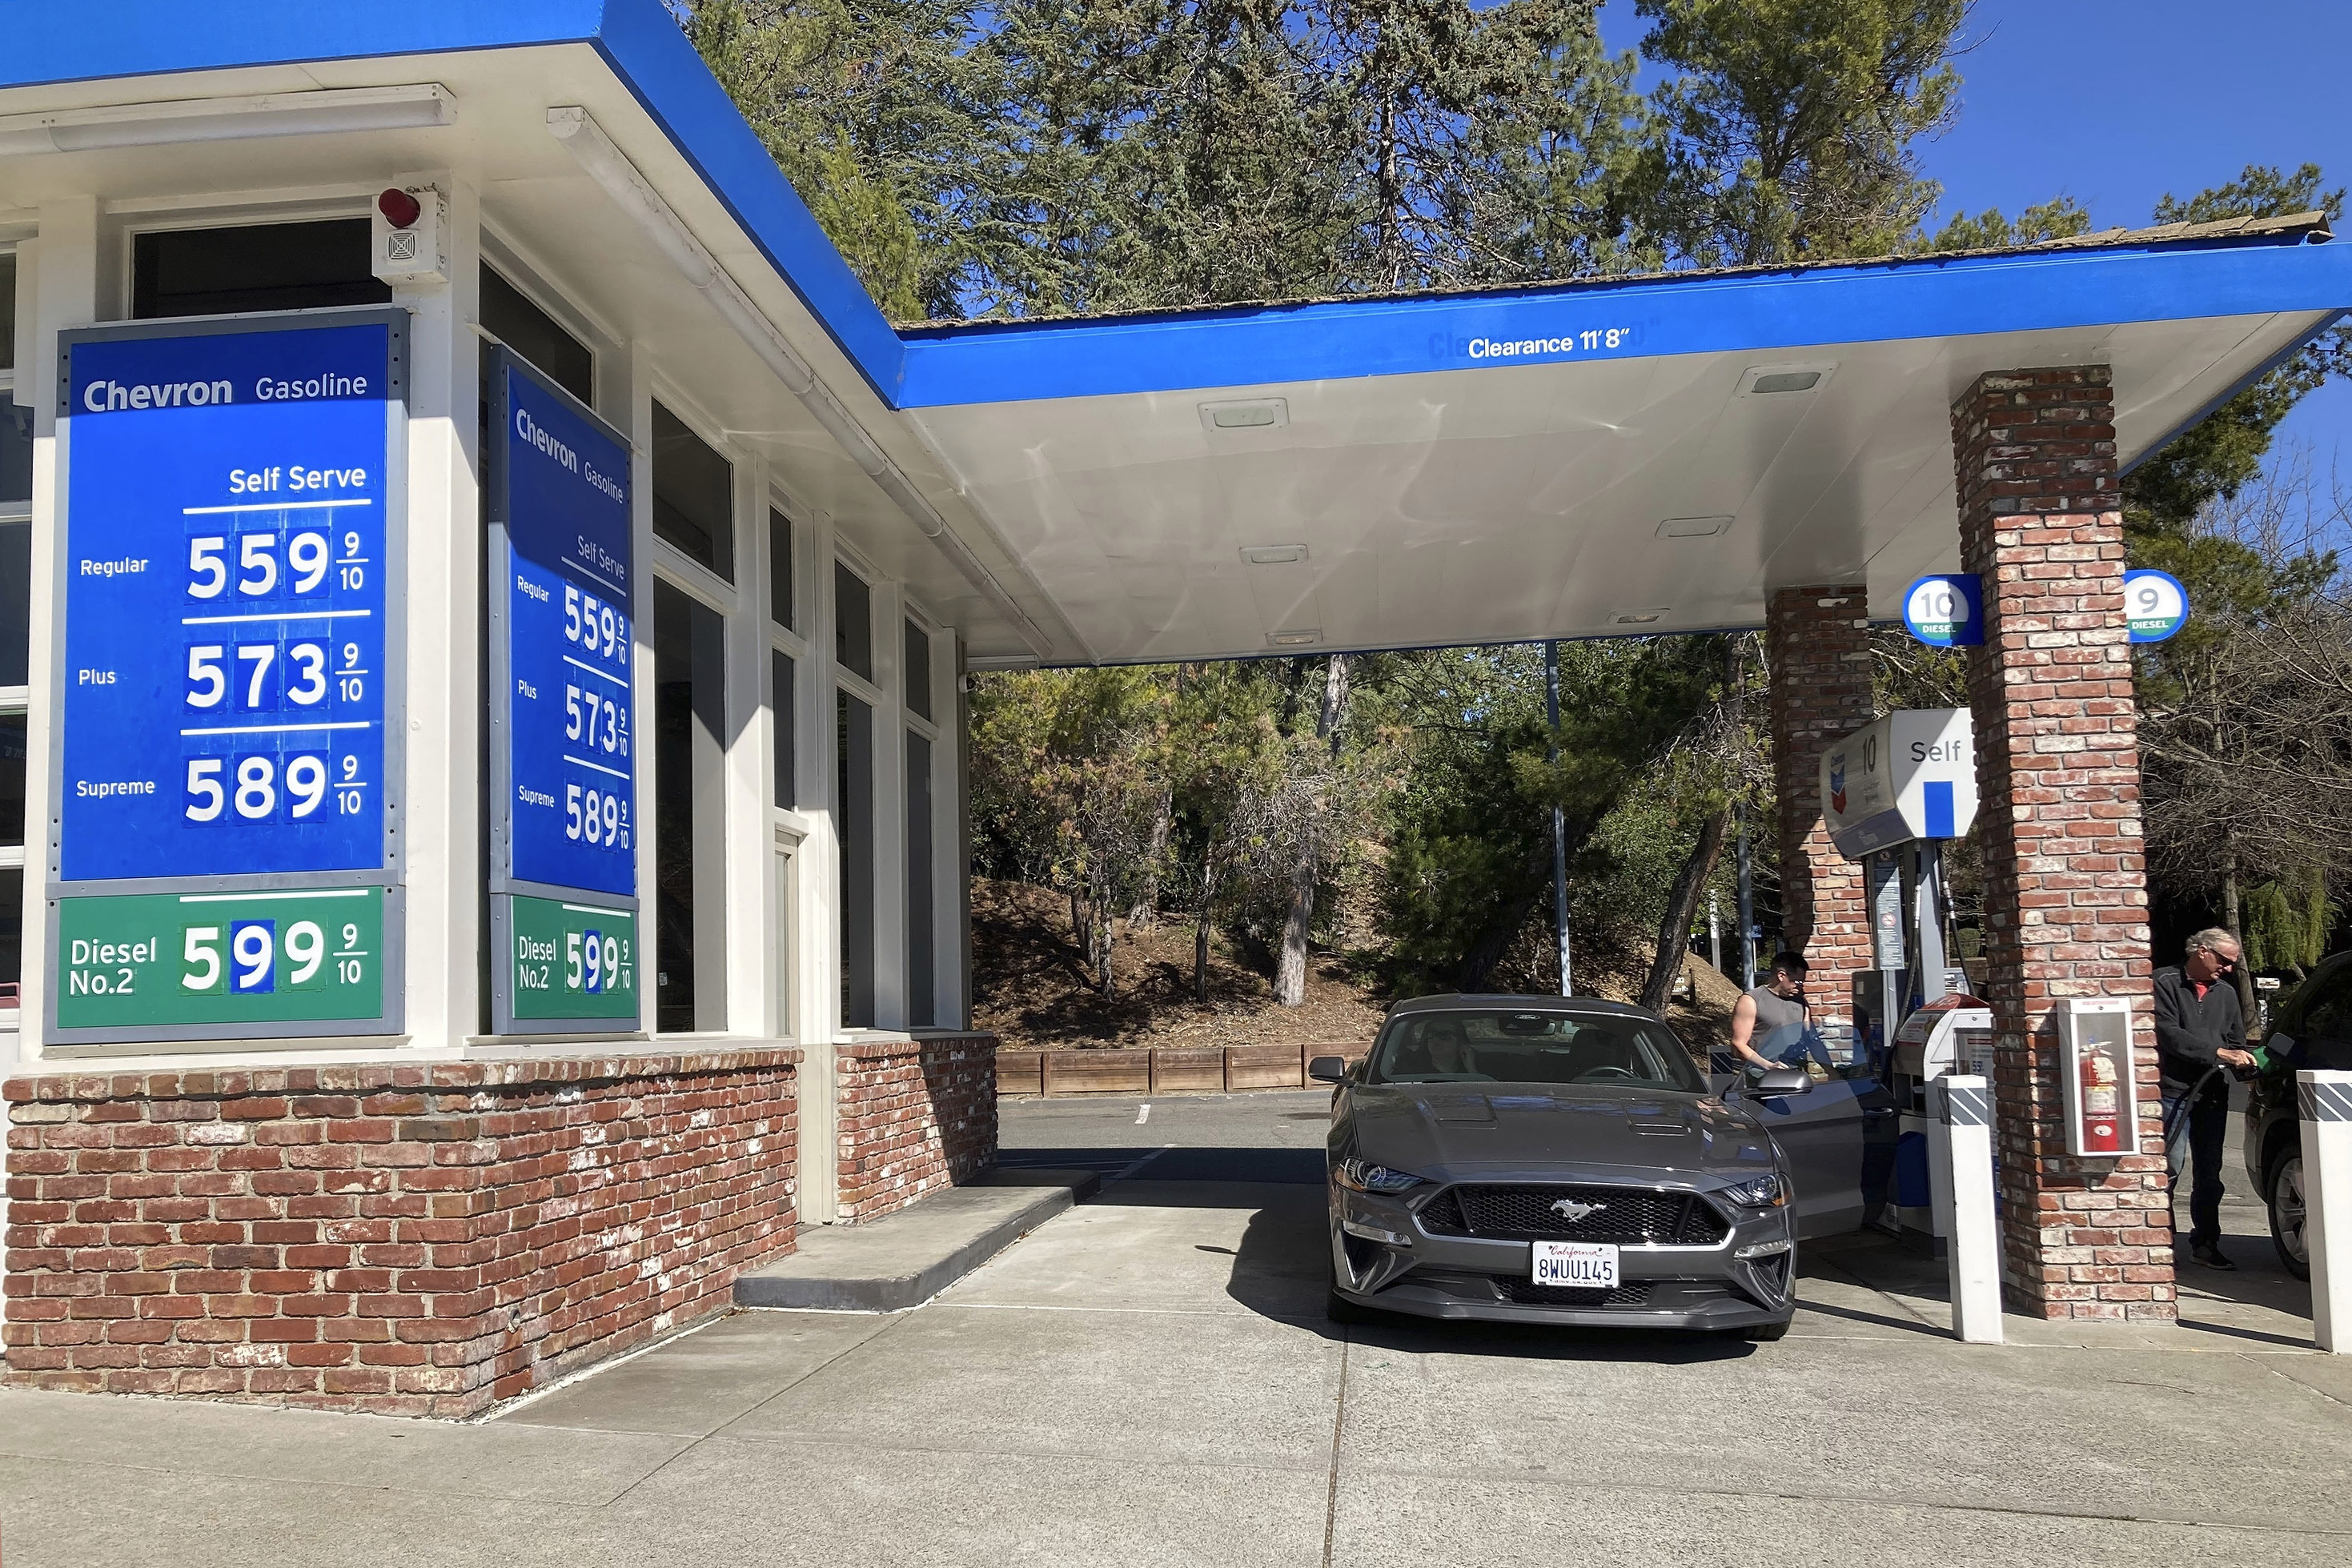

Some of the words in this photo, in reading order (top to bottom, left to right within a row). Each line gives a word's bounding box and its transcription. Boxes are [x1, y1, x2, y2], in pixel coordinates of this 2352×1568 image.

[1468, 337, 1574, 359] Clearance
[83, 379, 232, 412] Chevron
[255, 372, 367, 400] Gasoline
[516, 408, 577, 474] Chevron
[584, 461, 624, 504] Gasoline
[229, 467, 280, 494] Self
[288, 466, 367, 489] Serve
[344, 531, 359, 557] 9
[577, 534, 596, 563] Self
[599, 547, 624, 580] Serve
[81, 556, 149, 577] Regular
[187, 532, 328, 599] 559
[340, 566, 363, 591] 10
[1921, 592, 1955, 617] 10
[2138, 588, 2158, 614] 9
[517, 575, 549, 604] Regular
[564, 583, 615, 658] 559
[618, 615, 624, 636] 9
[1922, 625, 1957, 633] DIESEL
[2131, 620, 2169, 629] DIESEL
[343, 643, 359, 668] 9
[78, 668, 116, 686] Plus
[186, 643, 327, 708] 573
[339, 679, 363, 702] 10
[518, 679, 537, 700] Plus
[565, 684, 616, 753] 573
[620, 707, 626, 728] 9
[1863, 734, 1876, 775] 10
[1910, 740, 1961, 762] Self
[343, 755, 358, 781] 9
[76, 780, 155, 800] Supreme
[185, 755, 326, 822] 589
[337, 790, 362, 815] 10
[519, 784, 555, 808] Supreme
[565, 784, 618, 847] 589
[621, 800, 627, 821] 9
[342, 923, 358, 950] 9
[519, 936, 556, 961] Diesel
[622, 939, 628, 960] 9
[71, 936, 156, 965] Diesel
[181, 920, 325, 990] 599
[566, 932, 619, 989] 599
[70, 969, 134, 996] No.2
[337, 959, 362, 984] 10
[519, 964, 548, 989] No.2
[1551, 1245, 1603, 1258] California
[1539, 1259, 1612, 1281] 8WUU145
